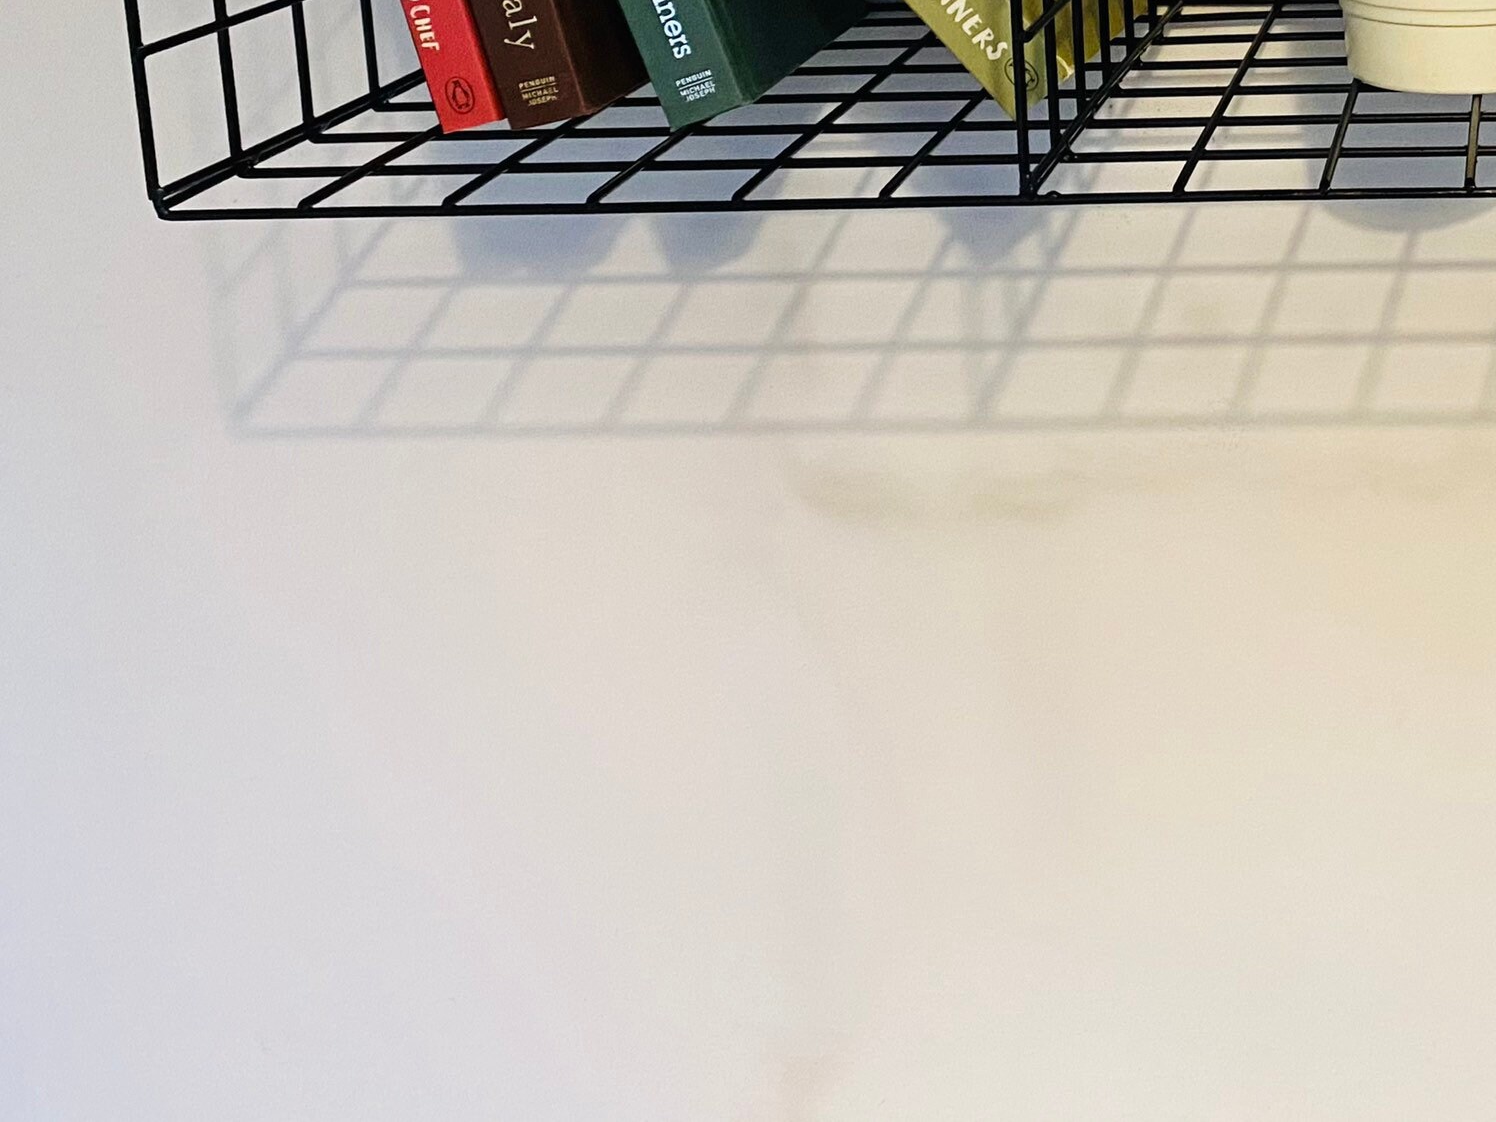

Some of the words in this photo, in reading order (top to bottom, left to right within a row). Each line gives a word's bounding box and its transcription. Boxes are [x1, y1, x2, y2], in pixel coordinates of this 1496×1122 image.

[410, 4, 440, 52] CHEF
[518, 76, 556, 90] PENGUIN
[675, 69, 712, 88] PENGUIN
[521, 87, 559, 100] MICHAEL
[679, 81, 716, 97] MICHAEL
[685, 87, 716, 103] JOSEPH
[528, 95, 558, 107] JOSEPH
